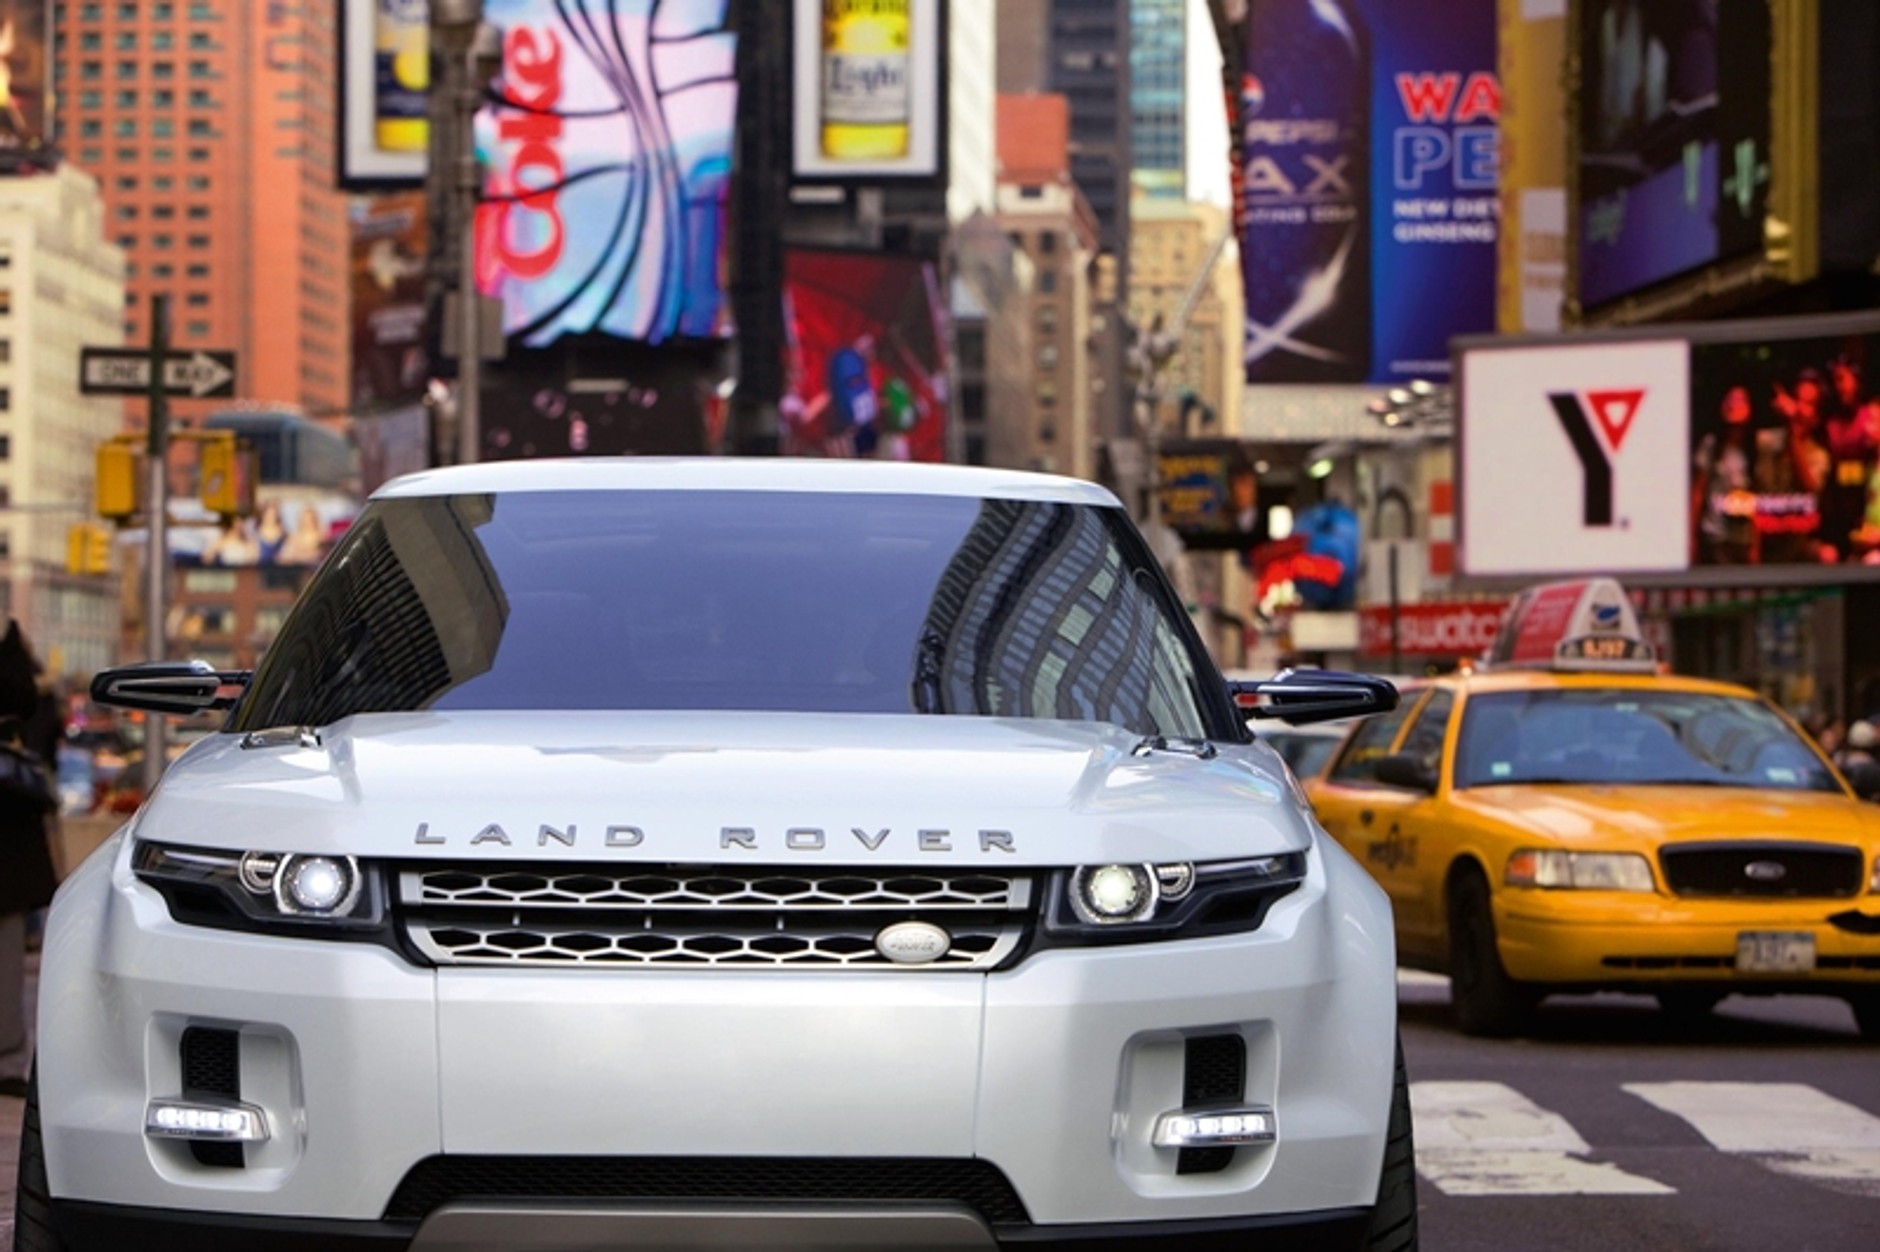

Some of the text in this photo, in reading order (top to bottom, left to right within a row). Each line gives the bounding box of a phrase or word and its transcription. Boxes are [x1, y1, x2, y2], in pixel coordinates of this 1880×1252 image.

[499, 23, 562, 281] Coke
[1393, 199, 1447, 219] NEW
[1393, 221, 1495, 243] GINSENG
[414, 822, 1016, 853] LAND ROVER
